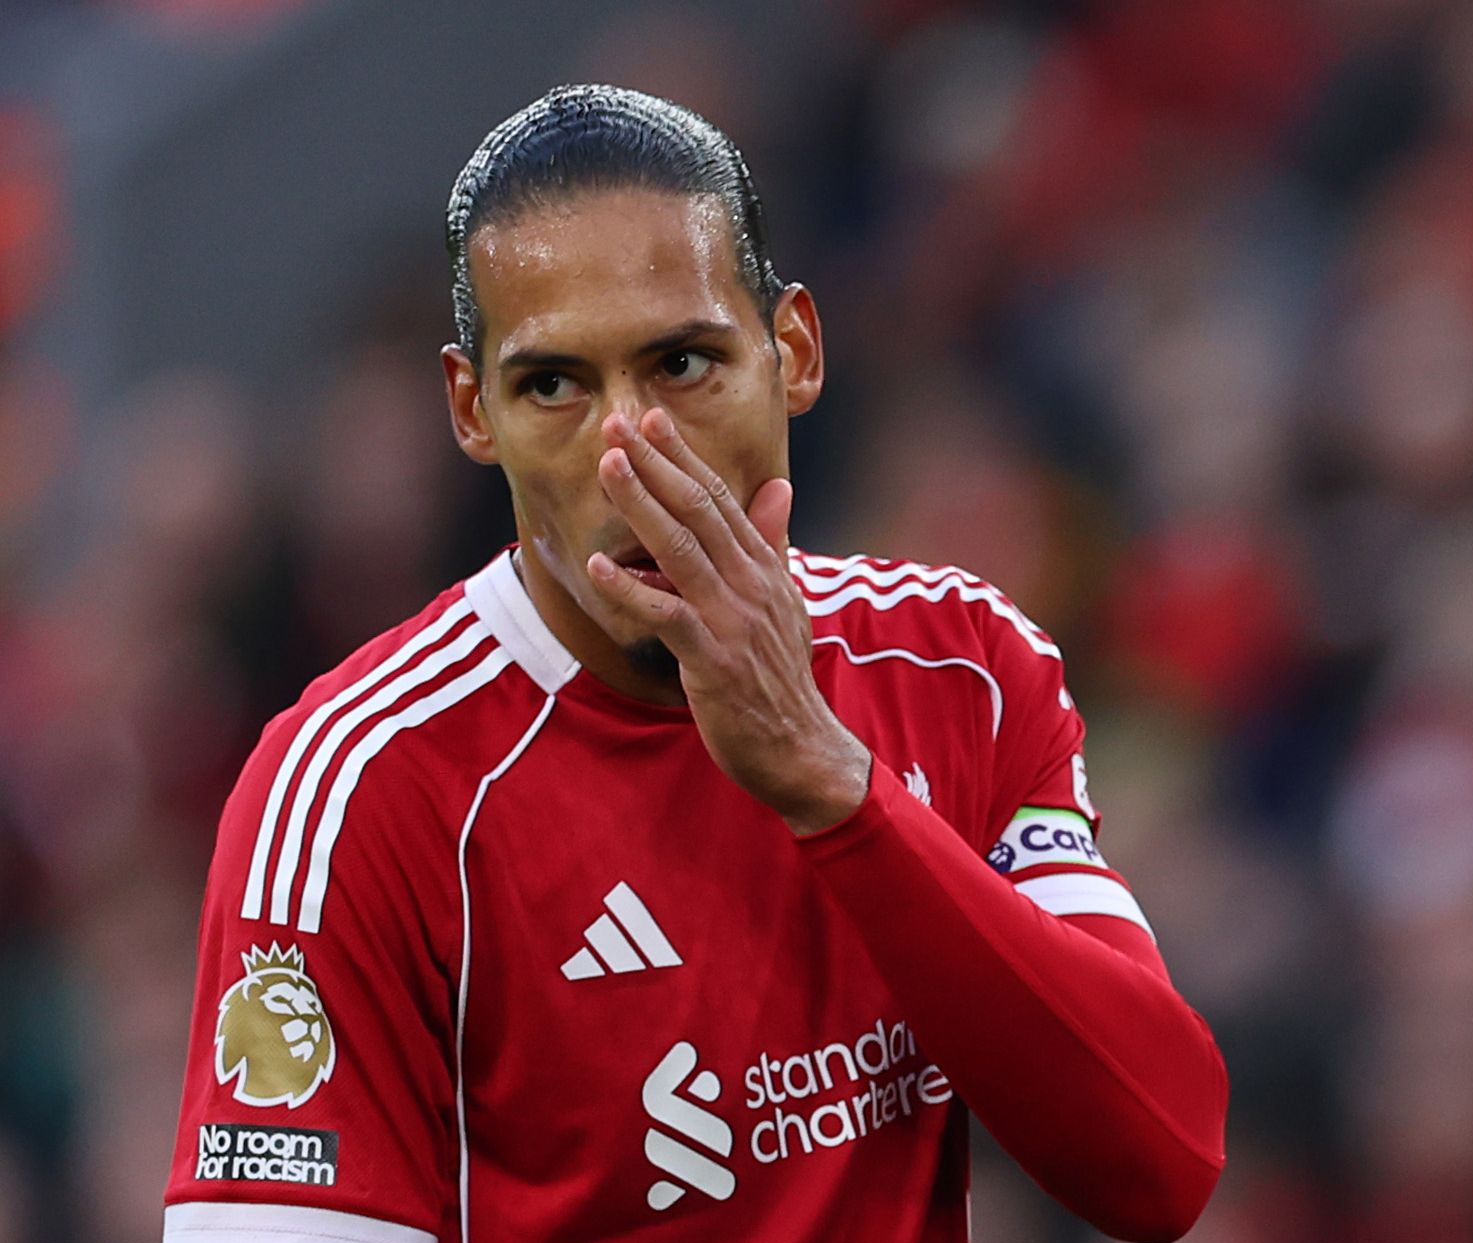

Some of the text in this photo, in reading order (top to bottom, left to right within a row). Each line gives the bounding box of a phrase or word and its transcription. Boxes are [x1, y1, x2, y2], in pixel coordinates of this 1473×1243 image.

[199, 1125, 322, 1159] No room
[195, 1152, 334, 1186] for racism
